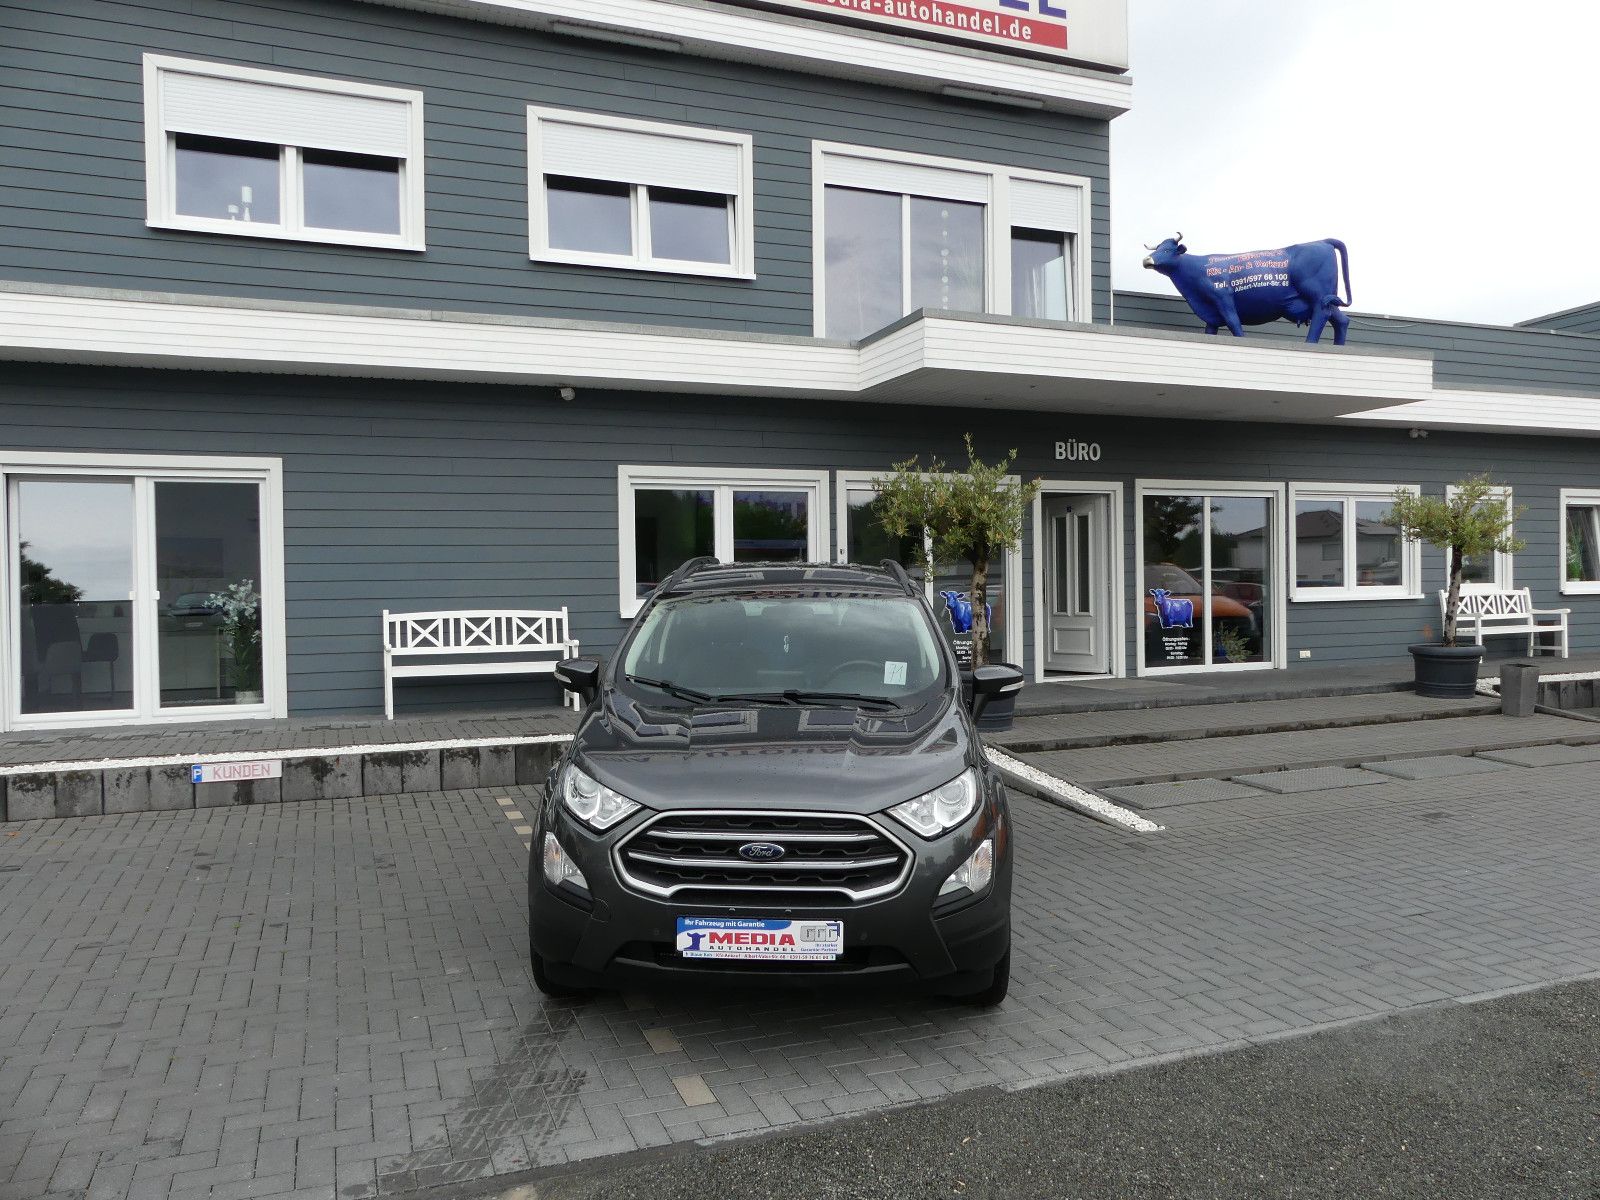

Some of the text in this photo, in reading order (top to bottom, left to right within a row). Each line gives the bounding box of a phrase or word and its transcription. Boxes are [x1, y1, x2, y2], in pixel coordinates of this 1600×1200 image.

[1231, 275, 1261, 287] 0391/597
[1263, 273, 1273, 281] 68
[1275, 273, 1288, 281] 100
[1055, 438, 1101, 461] BÜRO
[213, 763, 271, 780] KUNDEN
[749, 845, 774, 857] Ford
[694, 920, 724, 928] Fahrzeug
[708, 931, 796, 946] MEDIA
